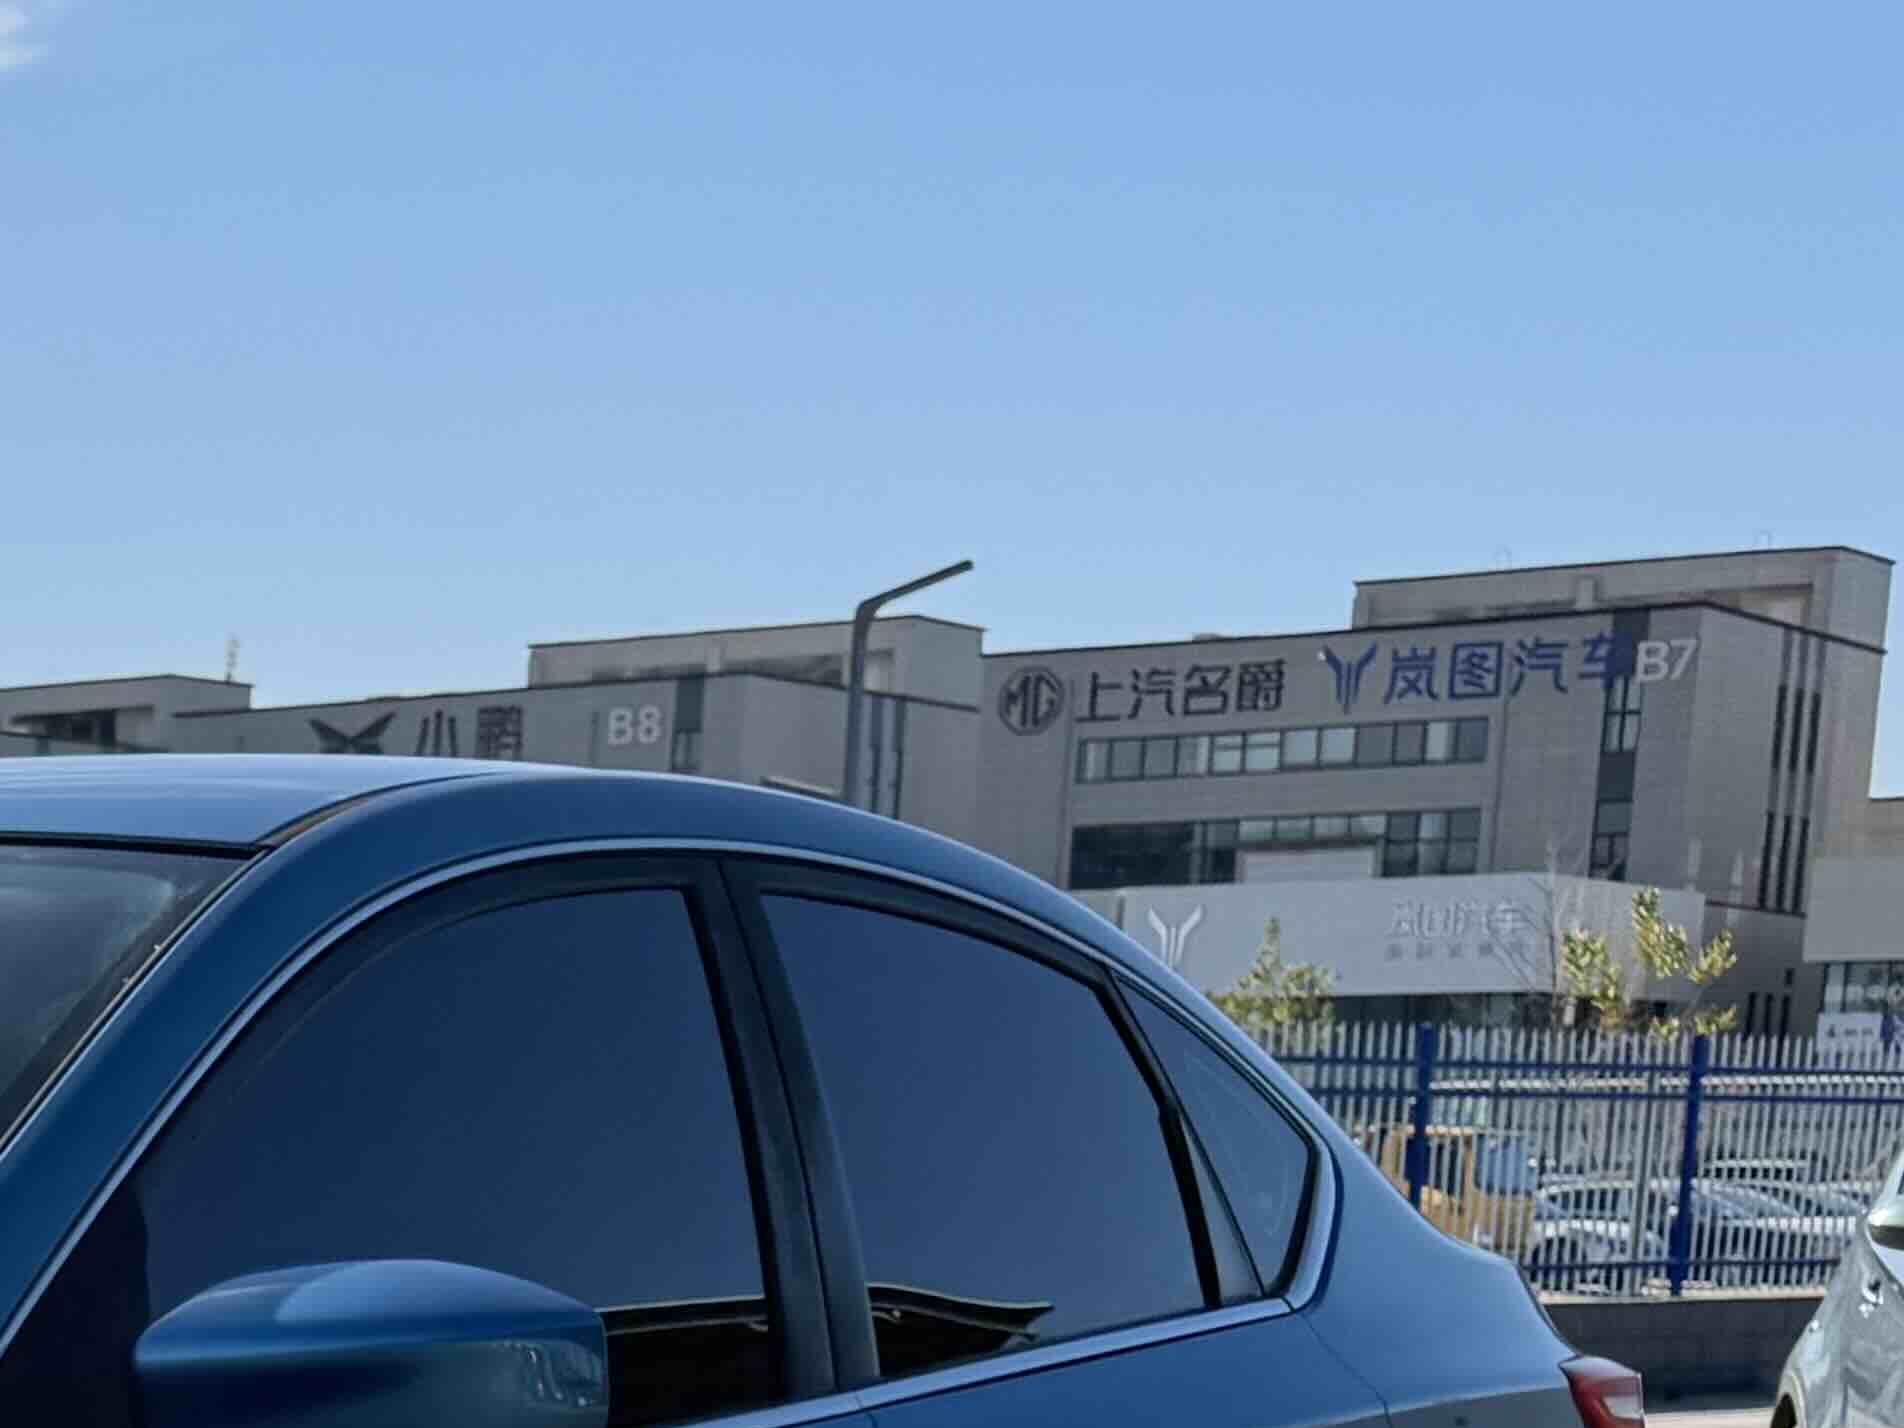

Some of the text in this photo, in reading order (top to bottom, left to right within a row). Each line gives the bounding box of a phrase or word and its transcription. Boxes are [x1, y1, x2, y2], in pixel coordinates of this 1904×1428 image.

[1384, 630, 1635, 706] 岚图汽车
[1635, 638, 1697, 687] B7
[1074, 660, 1285, 722] 上汽名爵
[606, 705, 662, 747] B8
